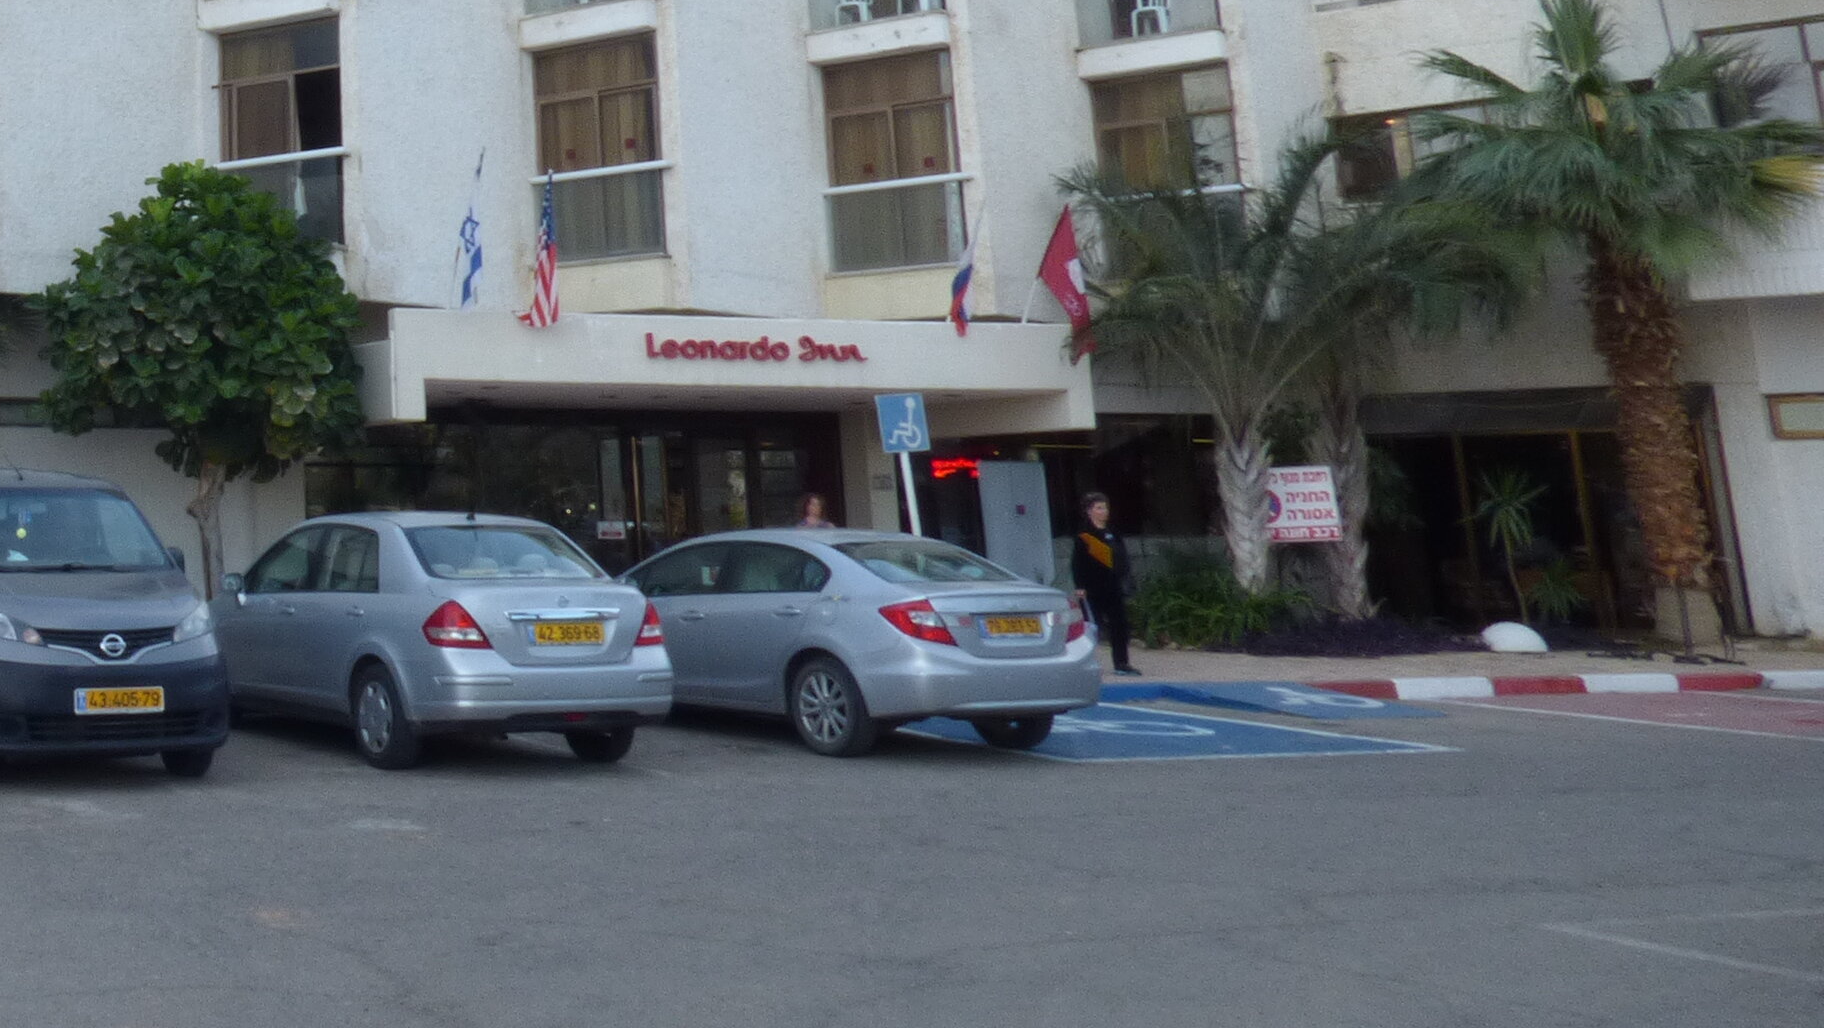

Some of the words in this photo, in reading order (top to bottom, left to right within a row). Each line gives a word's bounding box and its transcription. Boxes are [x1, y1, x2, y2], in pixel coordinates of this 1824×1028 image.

[645, 332, 790, 362] Leonardo
[798, 335, 868, 362] Inn
[1286, 491, 1330, 503] החניה
[1287, 508, 1336, 520] אסורה
[1312, 527, 1339, 539] רכב
